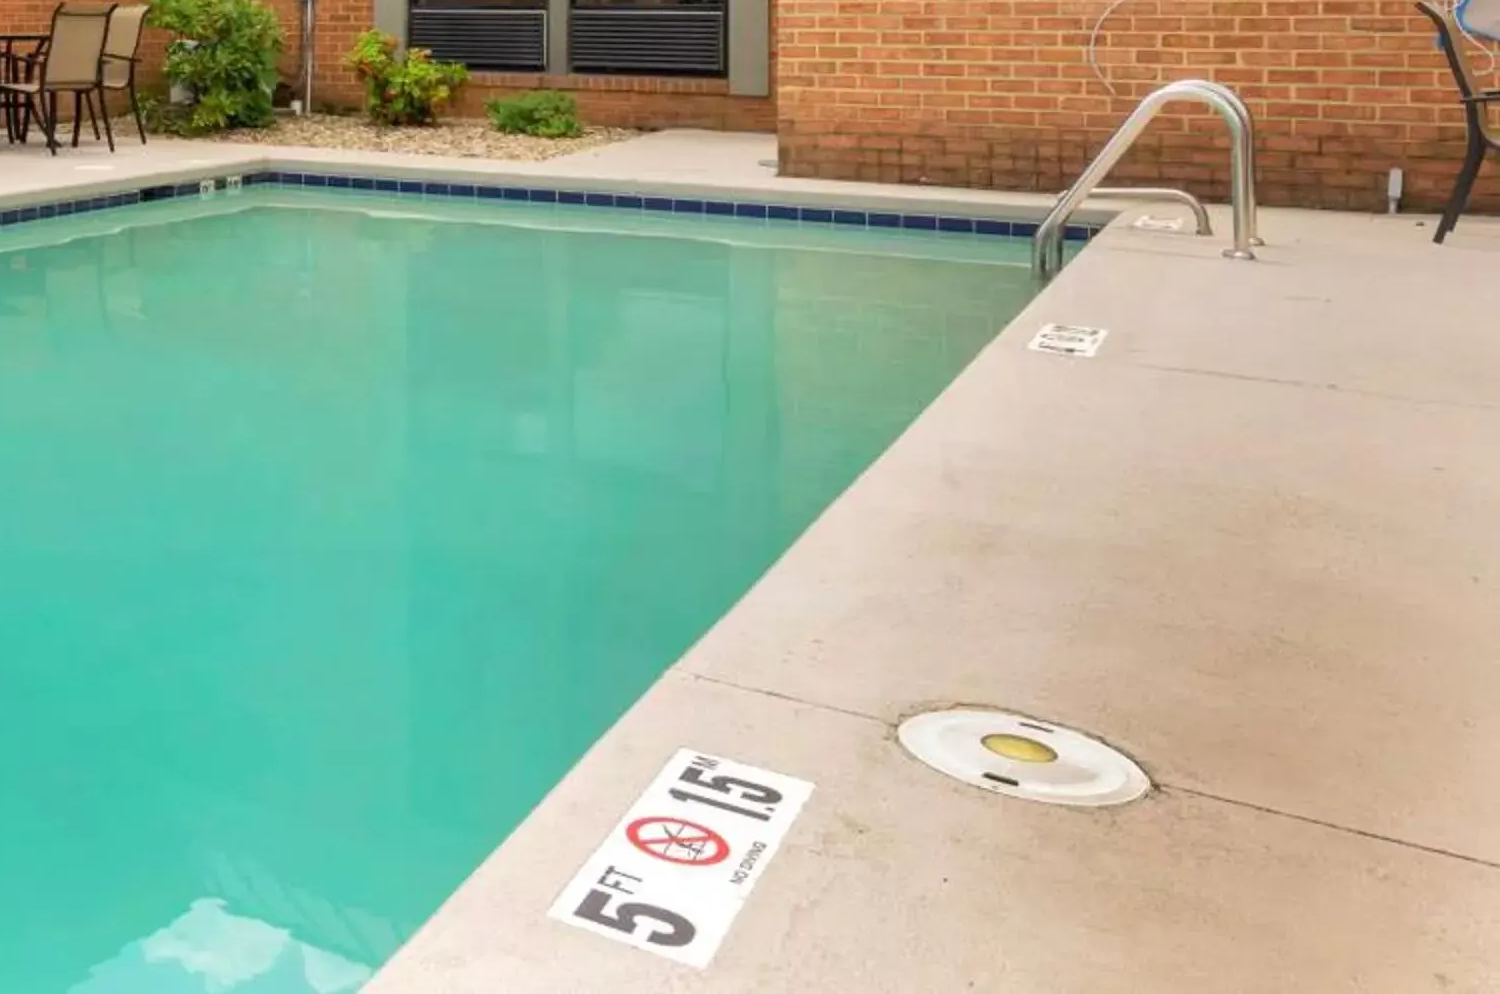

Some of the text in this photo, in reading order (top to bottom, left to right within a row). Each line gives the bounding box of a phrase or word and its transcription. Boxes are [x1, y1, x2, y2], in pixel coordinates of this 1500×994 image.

[728, 840, 768, 885] NO DIVING
[573, 865, 697, 947] 5 FT
